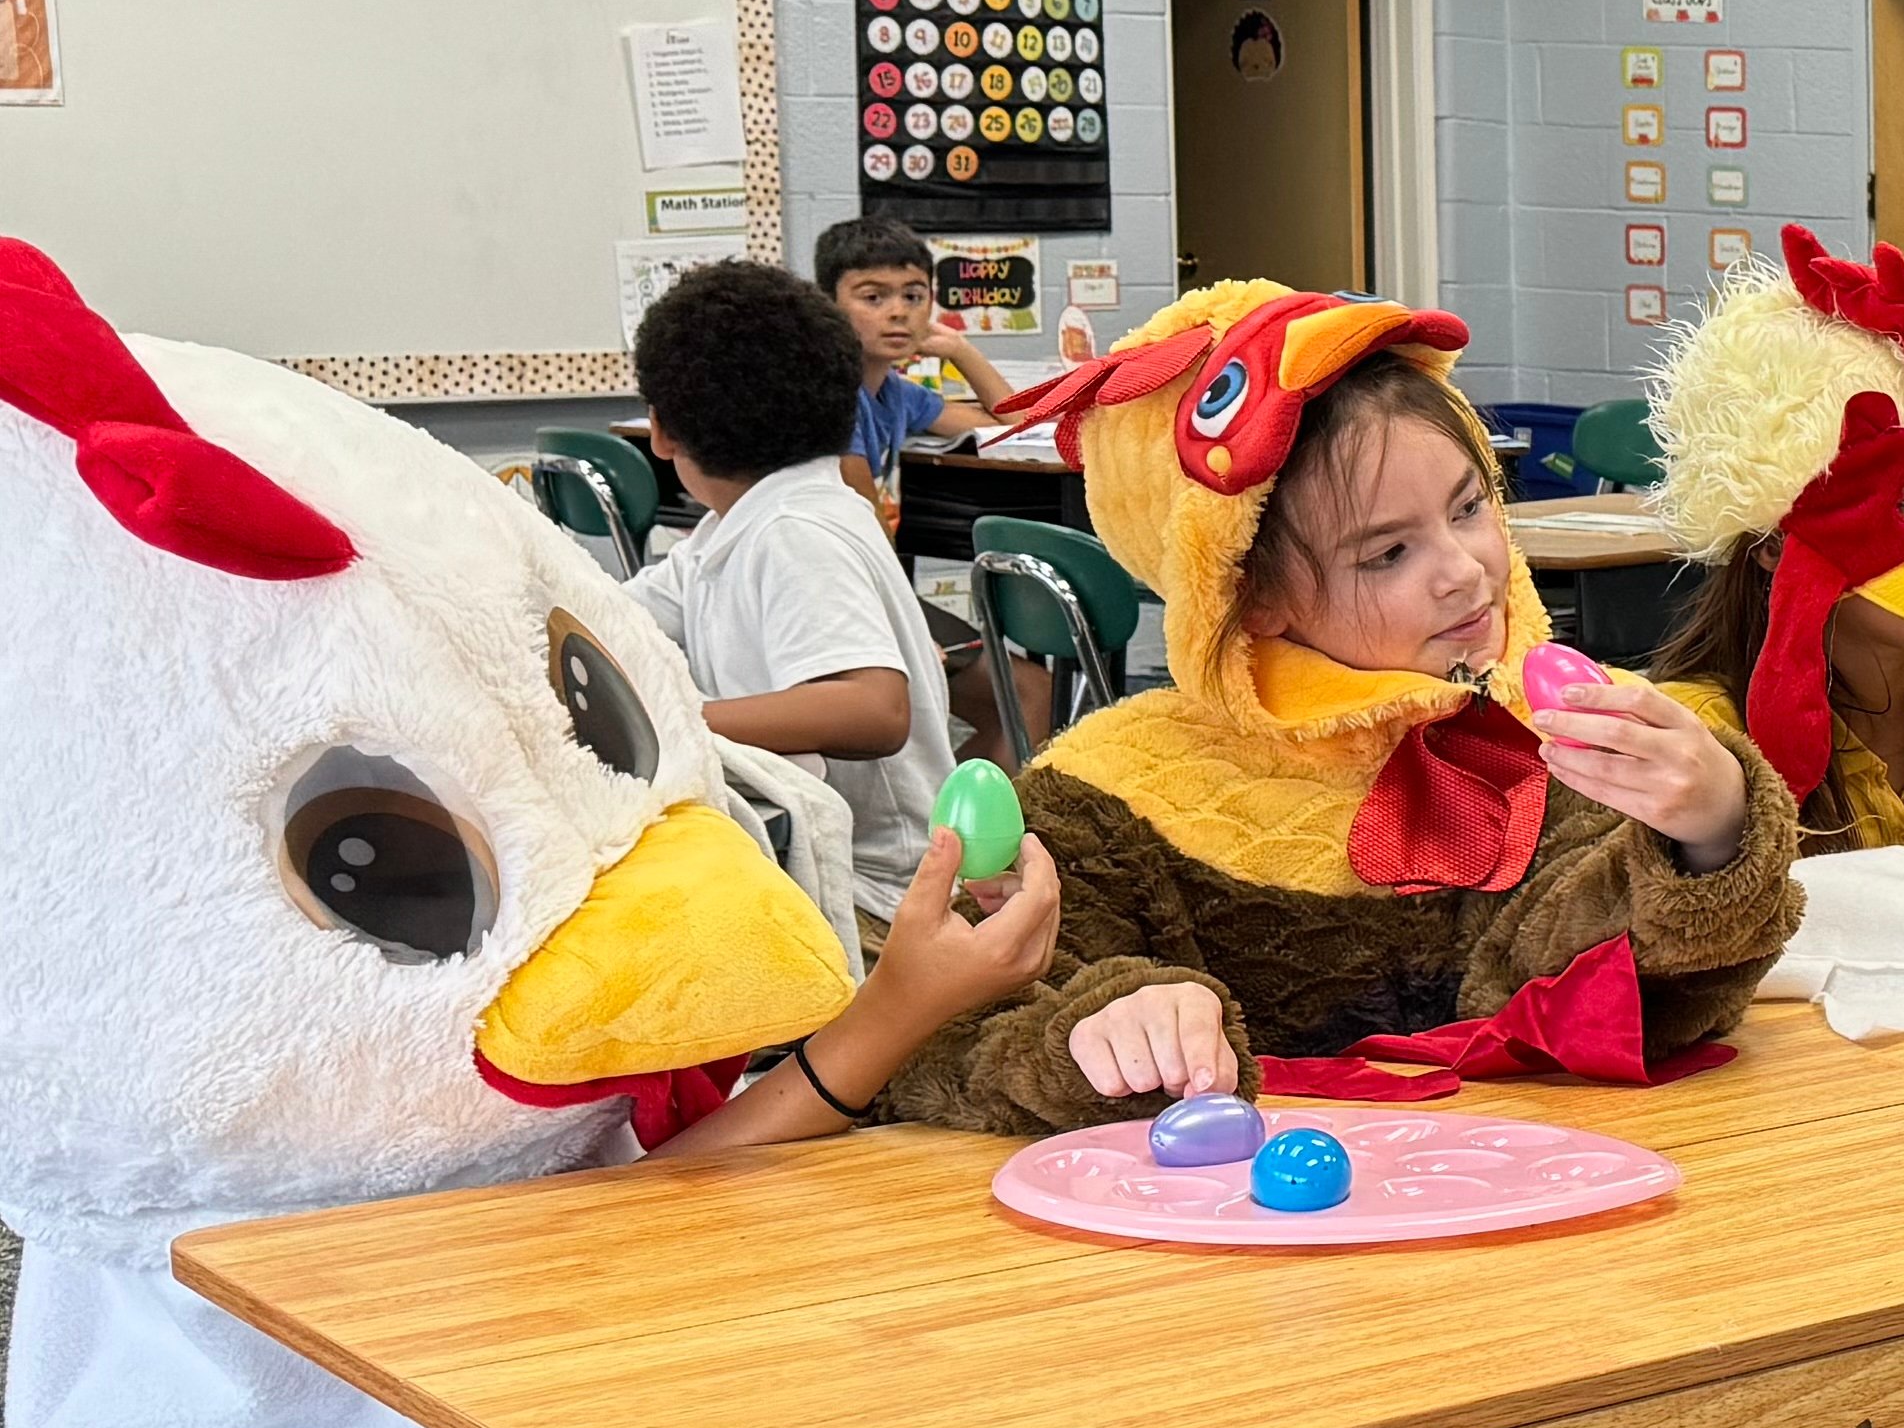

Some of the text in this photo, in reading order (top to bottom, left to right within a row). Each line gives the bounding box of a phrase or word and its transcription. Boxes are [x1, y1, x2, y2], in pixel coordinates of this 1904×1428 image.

[879, 26, 890, 44] 8
[914, 28, 926, 45] 9
[953, 30, 971, 48] 10
[1022, 34, 1037, 51] 12
[1052, 35, 1066, 52] 13
[877, 69, 896, 88] 15
[949, 73, 967, 90] 17
[989, 73, 1005, 91] 18
[1084, 78, 1098, 94] 21
[871, 111, 891, 129] 22
[911, 113, 931, 130] 23
[985, 114, 1004, 132] 25
[1020, 114, 1037, 133] 26
[1081, 115, 1096, 132] 28
[870, 154, 970, 172] 29 30 31
[660, 198, 697, 212] Math
